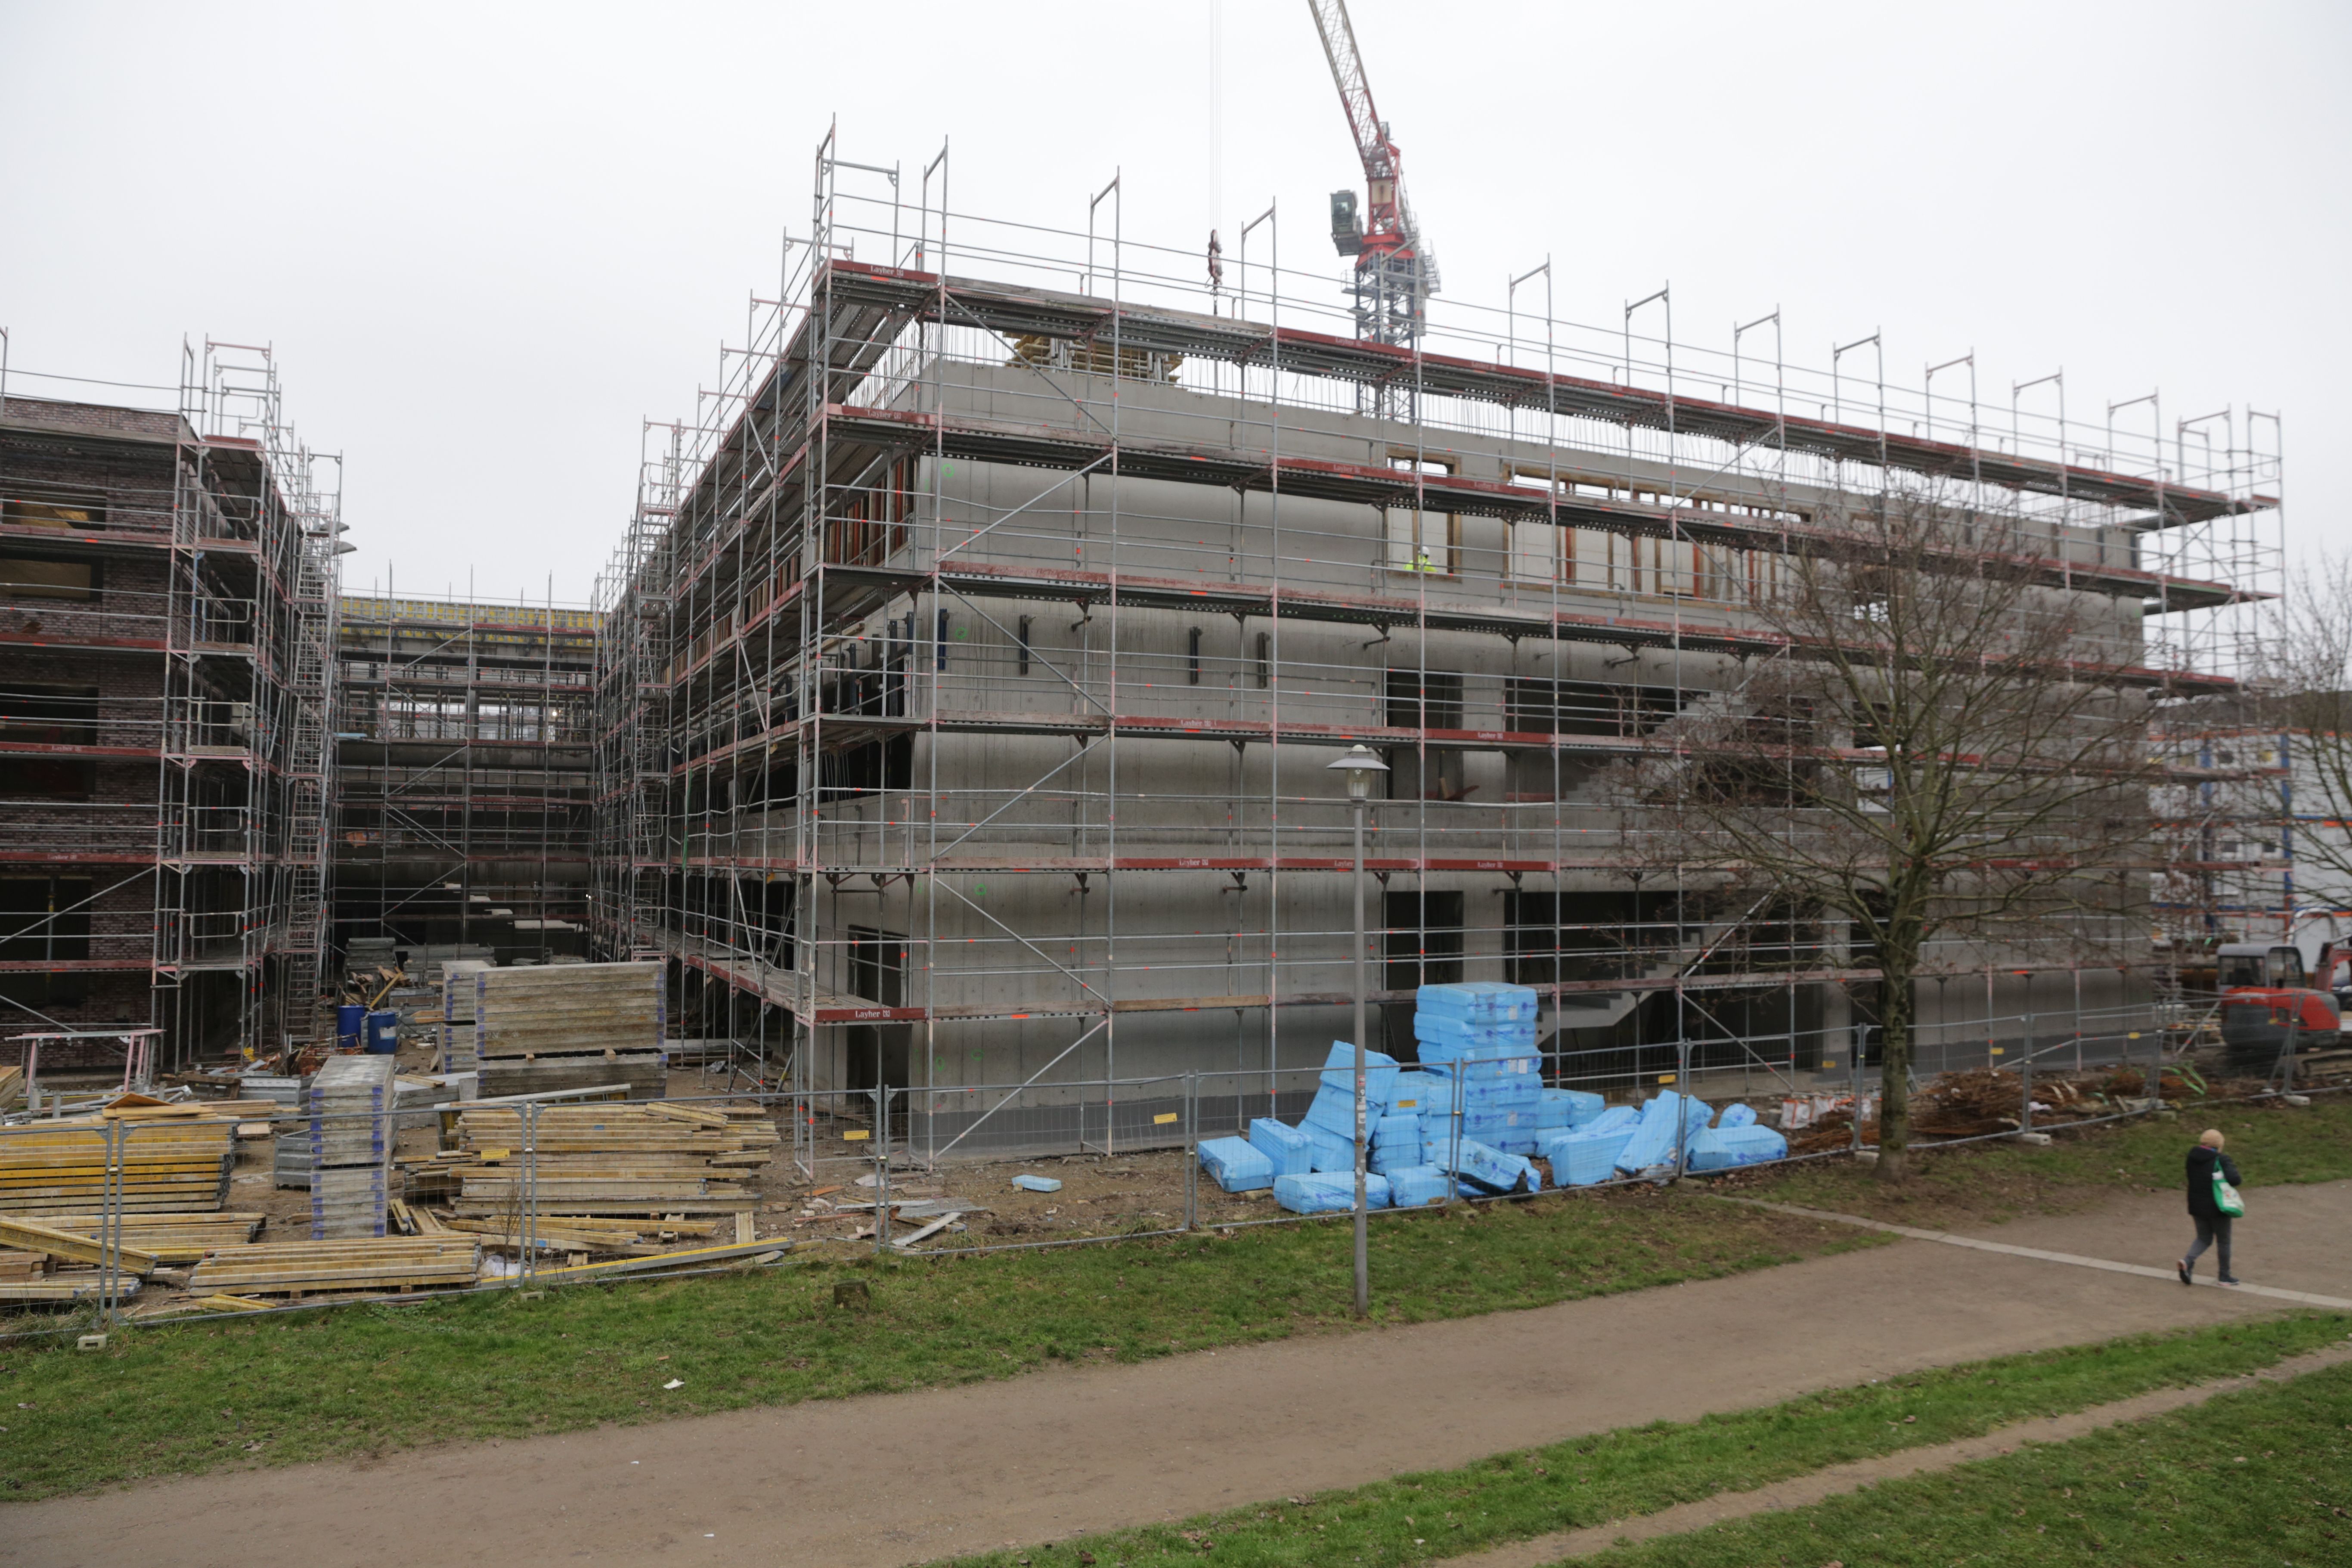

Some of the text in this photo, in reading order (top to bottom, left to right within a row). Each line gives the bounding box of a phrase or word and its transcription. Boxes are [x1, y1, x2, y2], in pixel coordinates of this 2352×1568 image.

[871, 265, 894, 275] Layher
[868, 410, 892, 419] Layher
[855, 1010, 880, 1019] Layher
